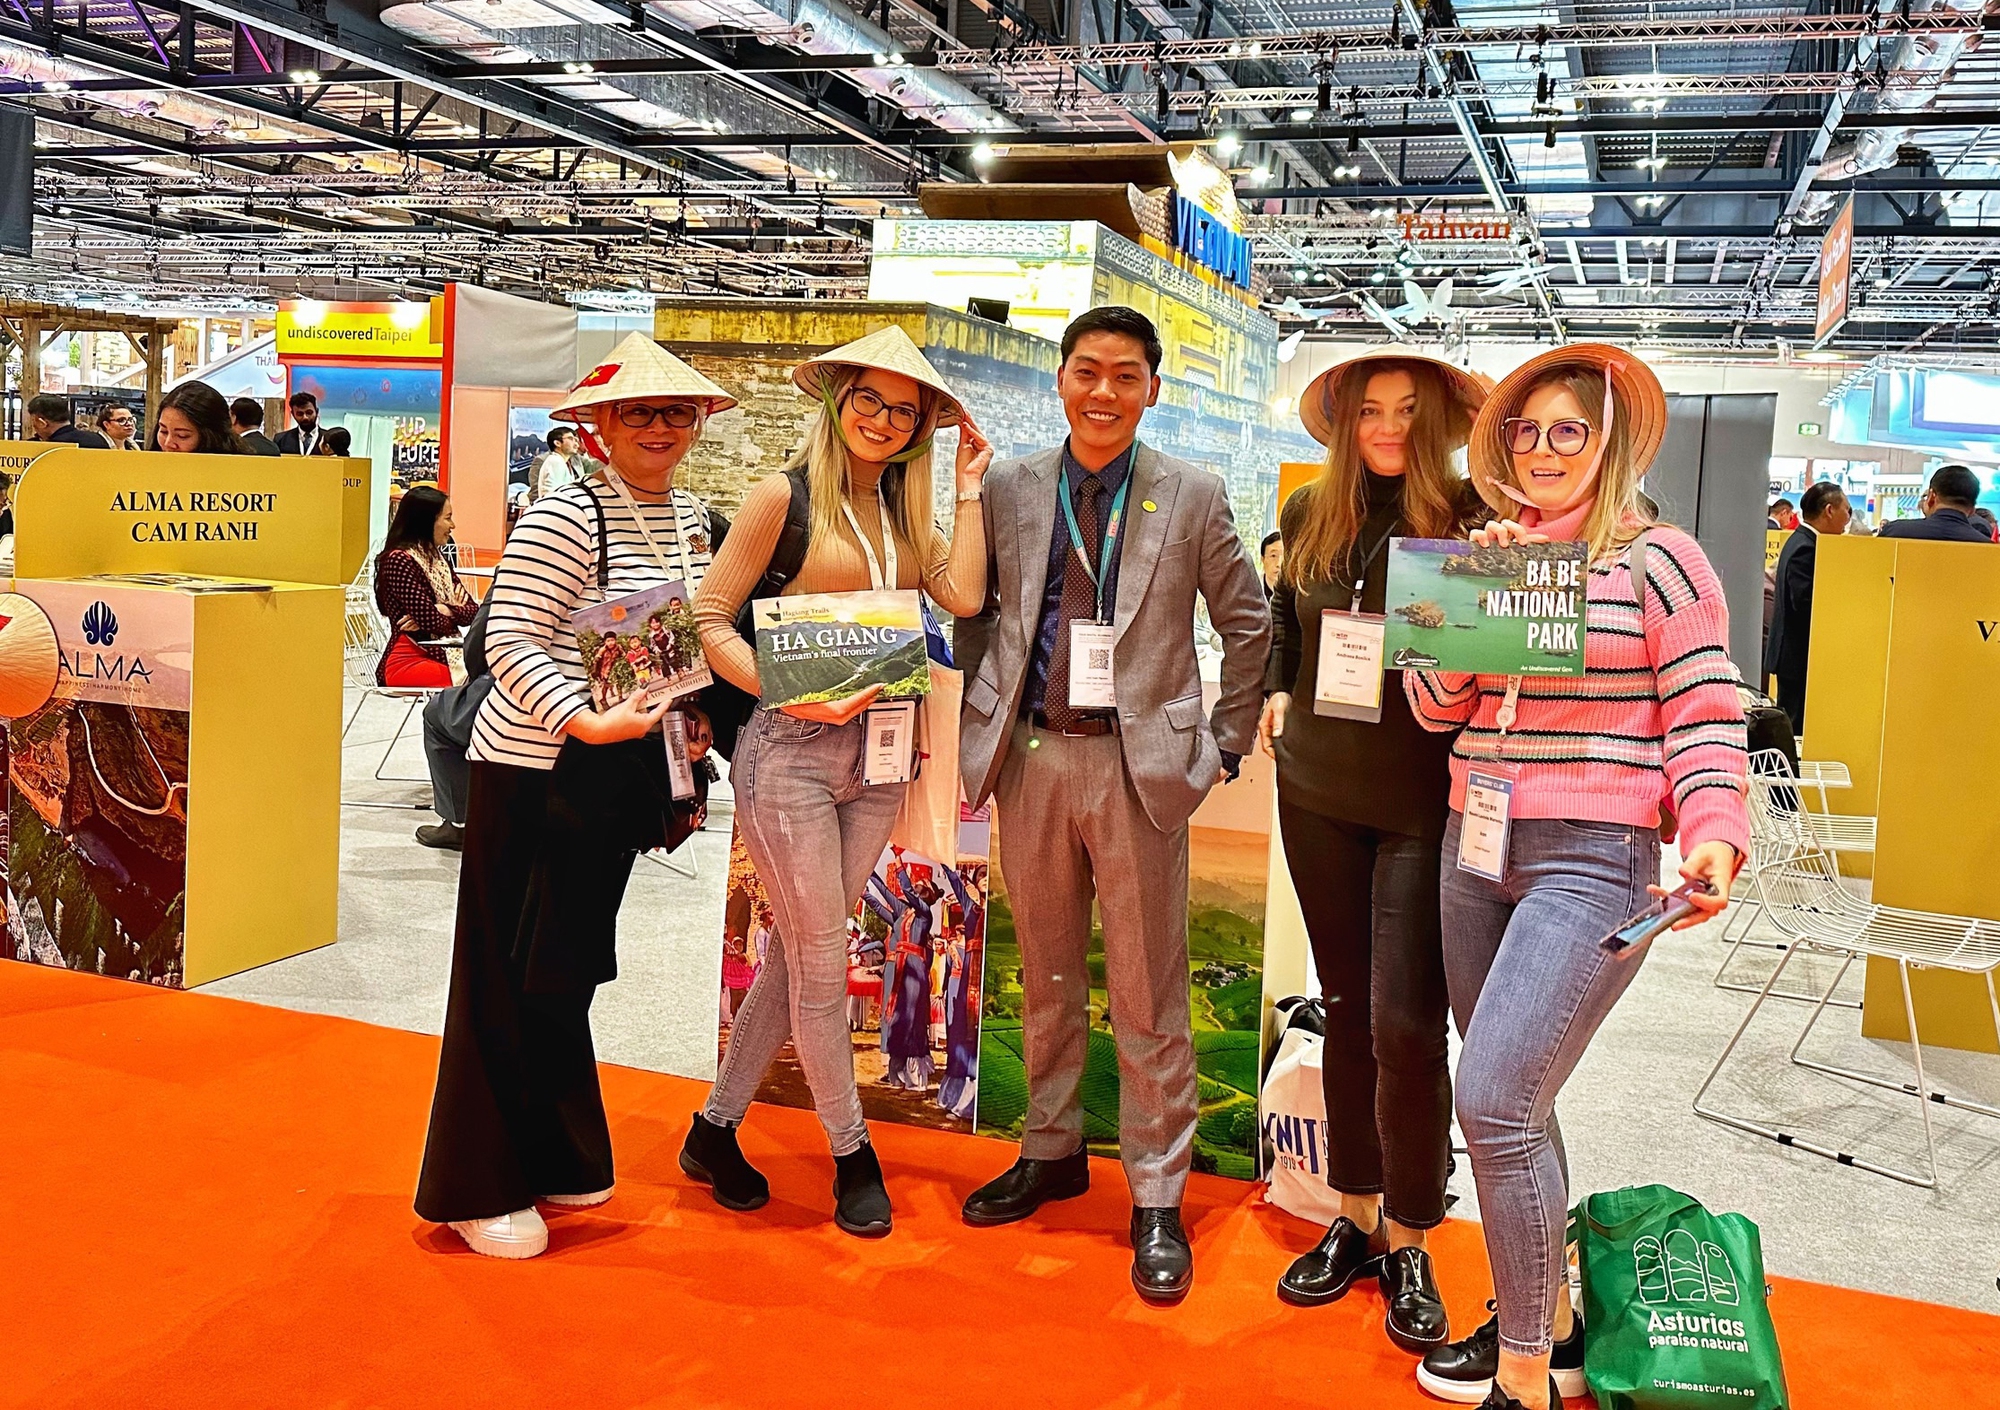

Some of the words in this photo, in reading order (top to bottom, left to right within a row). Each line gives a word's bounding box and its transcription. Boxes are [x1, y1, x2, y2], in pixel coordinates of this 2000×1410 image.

[1396, 213, 1512, 240] Taiwan
[255, 356, 279, 366] THAI
[110, 491, 184, 512] ALMA
[189, 493, 277, 513] RESORT
[131, 521, 188, 542] CAM
[194, 521, 258, 542] RANH
[1526, 560, 1553, 587] BA
[1557, 559, 1581, 587] BE
[1486, 590, 1580, 618] NATIONAL
[770, 631, 810, 652] HA
[815, 626, 898, 649] GIANG
[1526, 622, 1579, 650] PARK
[772, 651, 819, 664] Vietnam's
[820, 649, 841, 659] final
[842, 646, 878, 657] frontier
[59, 649, 154, 684] ALMA
[669, 675, 710, 693] CAMBODIA
[1280, 1155, 1297, 1171] 1919
[1647, 1310, 1746, 1338] Asturias
[1648, 1332, 1699, 1349] paraíso
[1700, 1335, 1749, 1354] natural
[1653, 1378, 1755, 1397] turismoasturias.es
